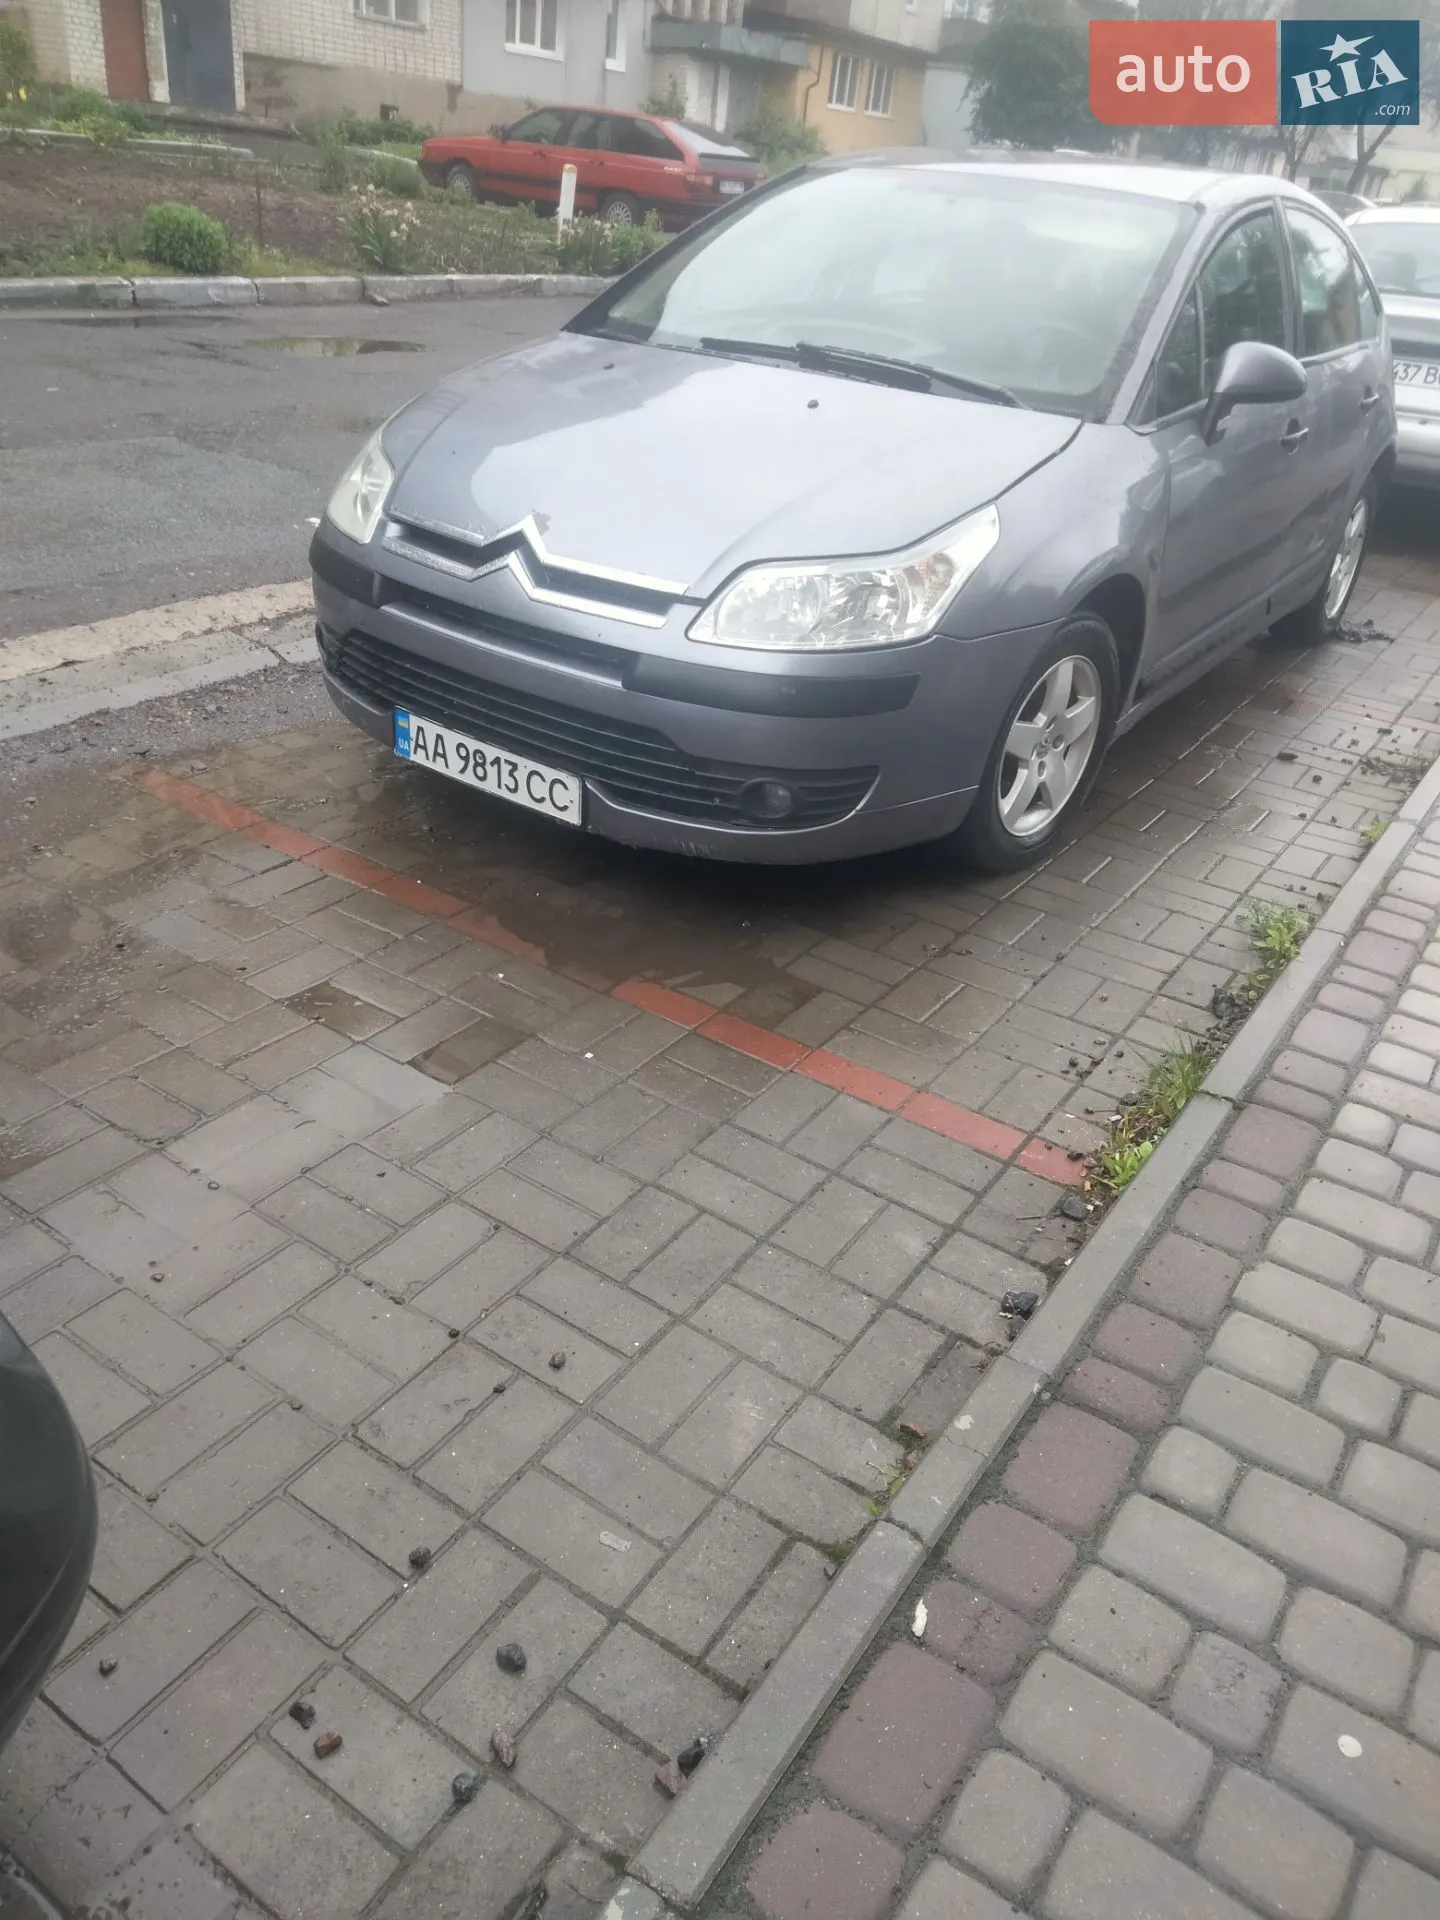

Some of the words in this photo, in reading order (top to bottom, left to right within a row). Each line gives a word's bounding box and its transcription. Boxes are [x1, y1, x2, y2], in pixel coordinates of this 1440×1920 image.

[398, 737, 409, 751] UA
[455, 742, 519, 793] 9813
[526, 769, 570, 812] CC
